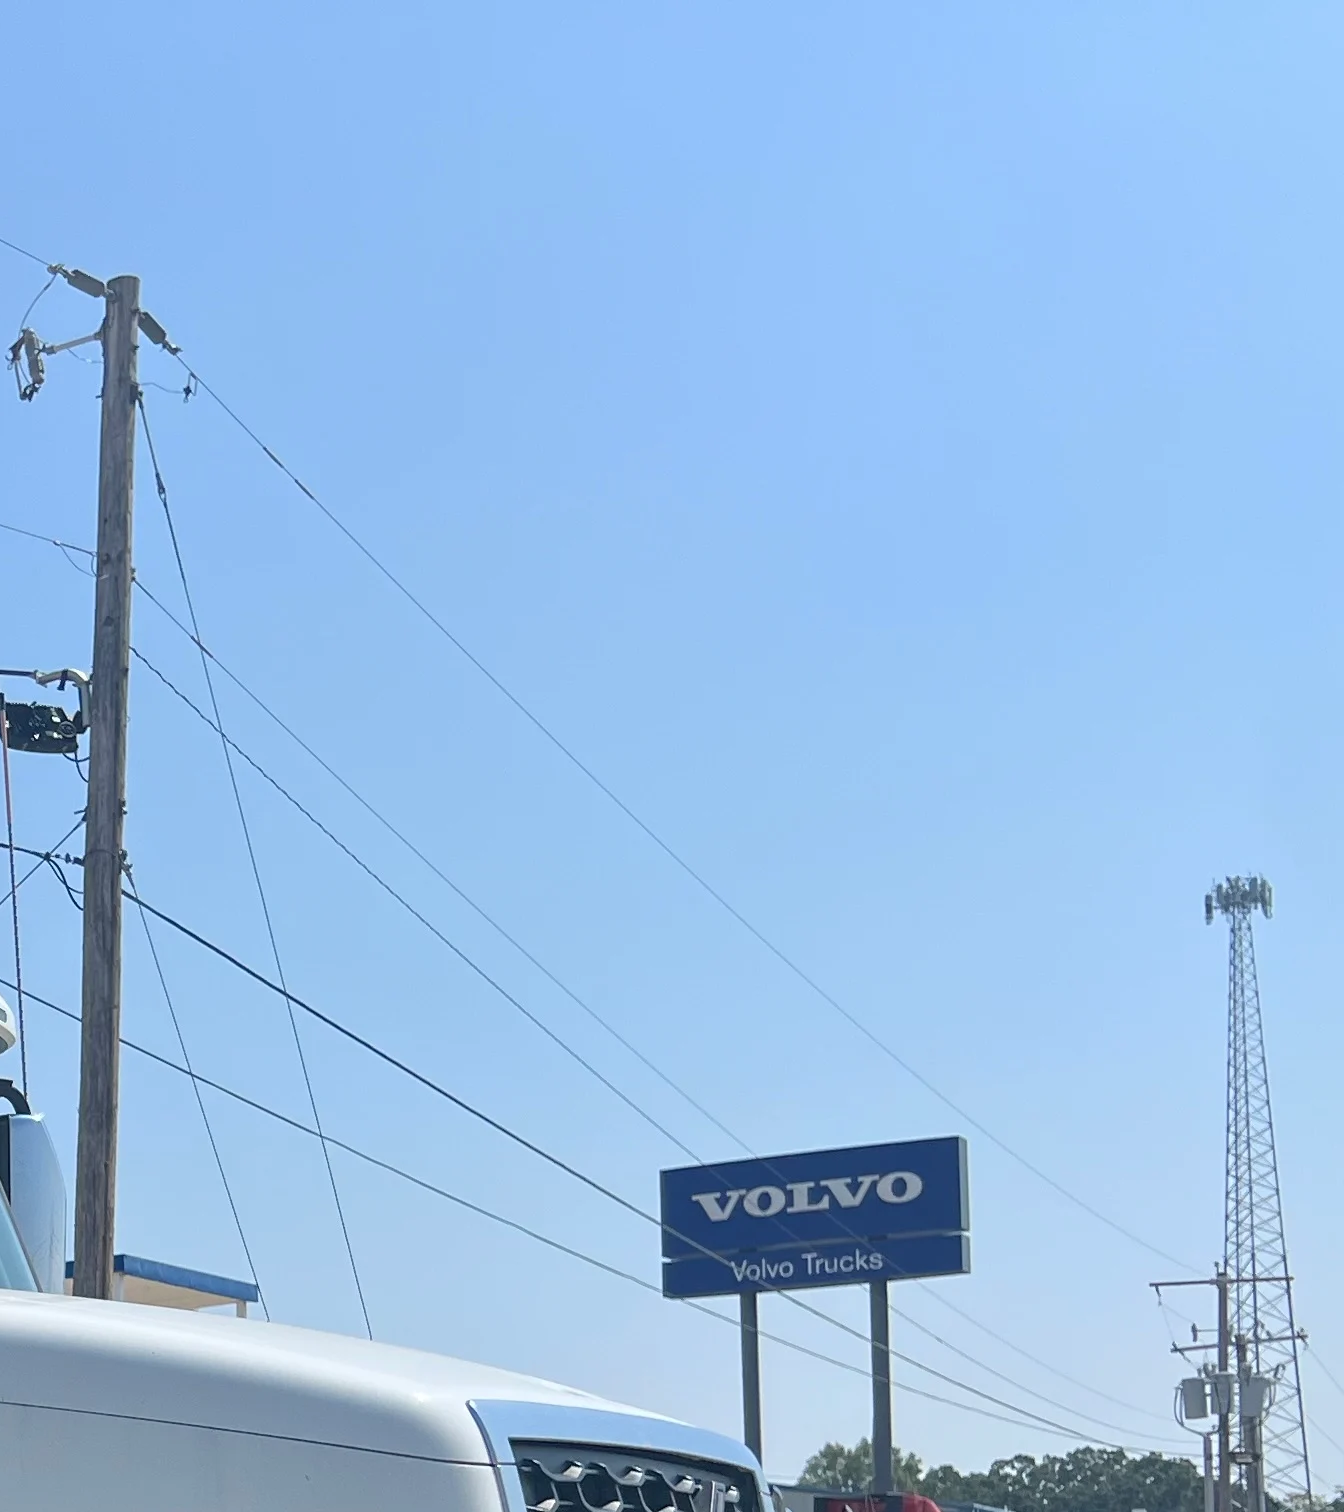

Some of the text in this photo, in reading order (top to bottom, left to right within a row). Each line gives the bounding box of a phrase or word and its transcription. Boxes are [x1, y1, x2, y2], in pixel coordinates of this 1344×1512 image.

[691, 1171, 923, 1223] VOLVO
[729, 1249, 883, 1283] Volvo Trucks
